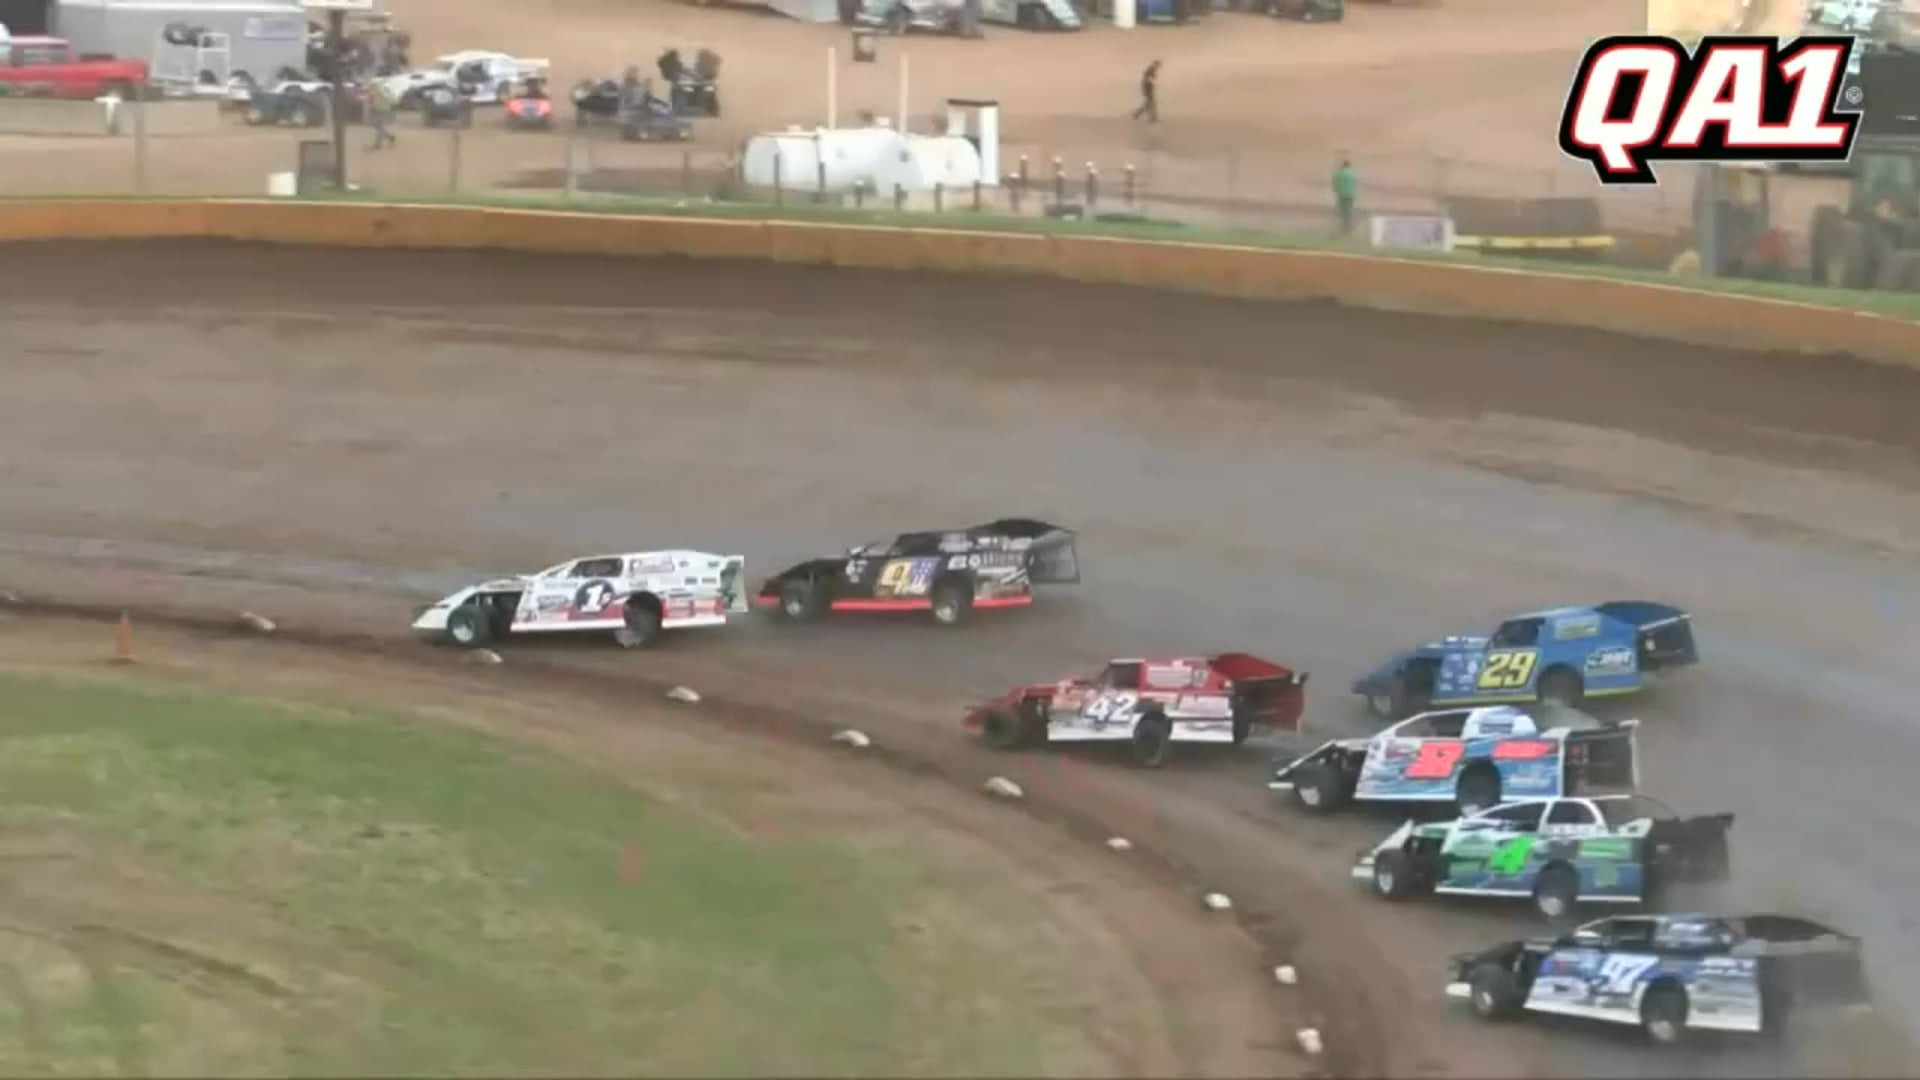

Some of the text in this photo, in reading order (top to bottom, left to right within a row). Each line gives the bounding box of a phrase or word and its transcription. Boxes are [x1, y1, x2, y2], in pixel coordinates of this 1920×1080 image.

[1477, 650, 1537, 689] 29
[1085, 692, 1138, 722] 42
[1489, 834, 1536, 876] 4
[1599, 953, 1660, 992] 97
